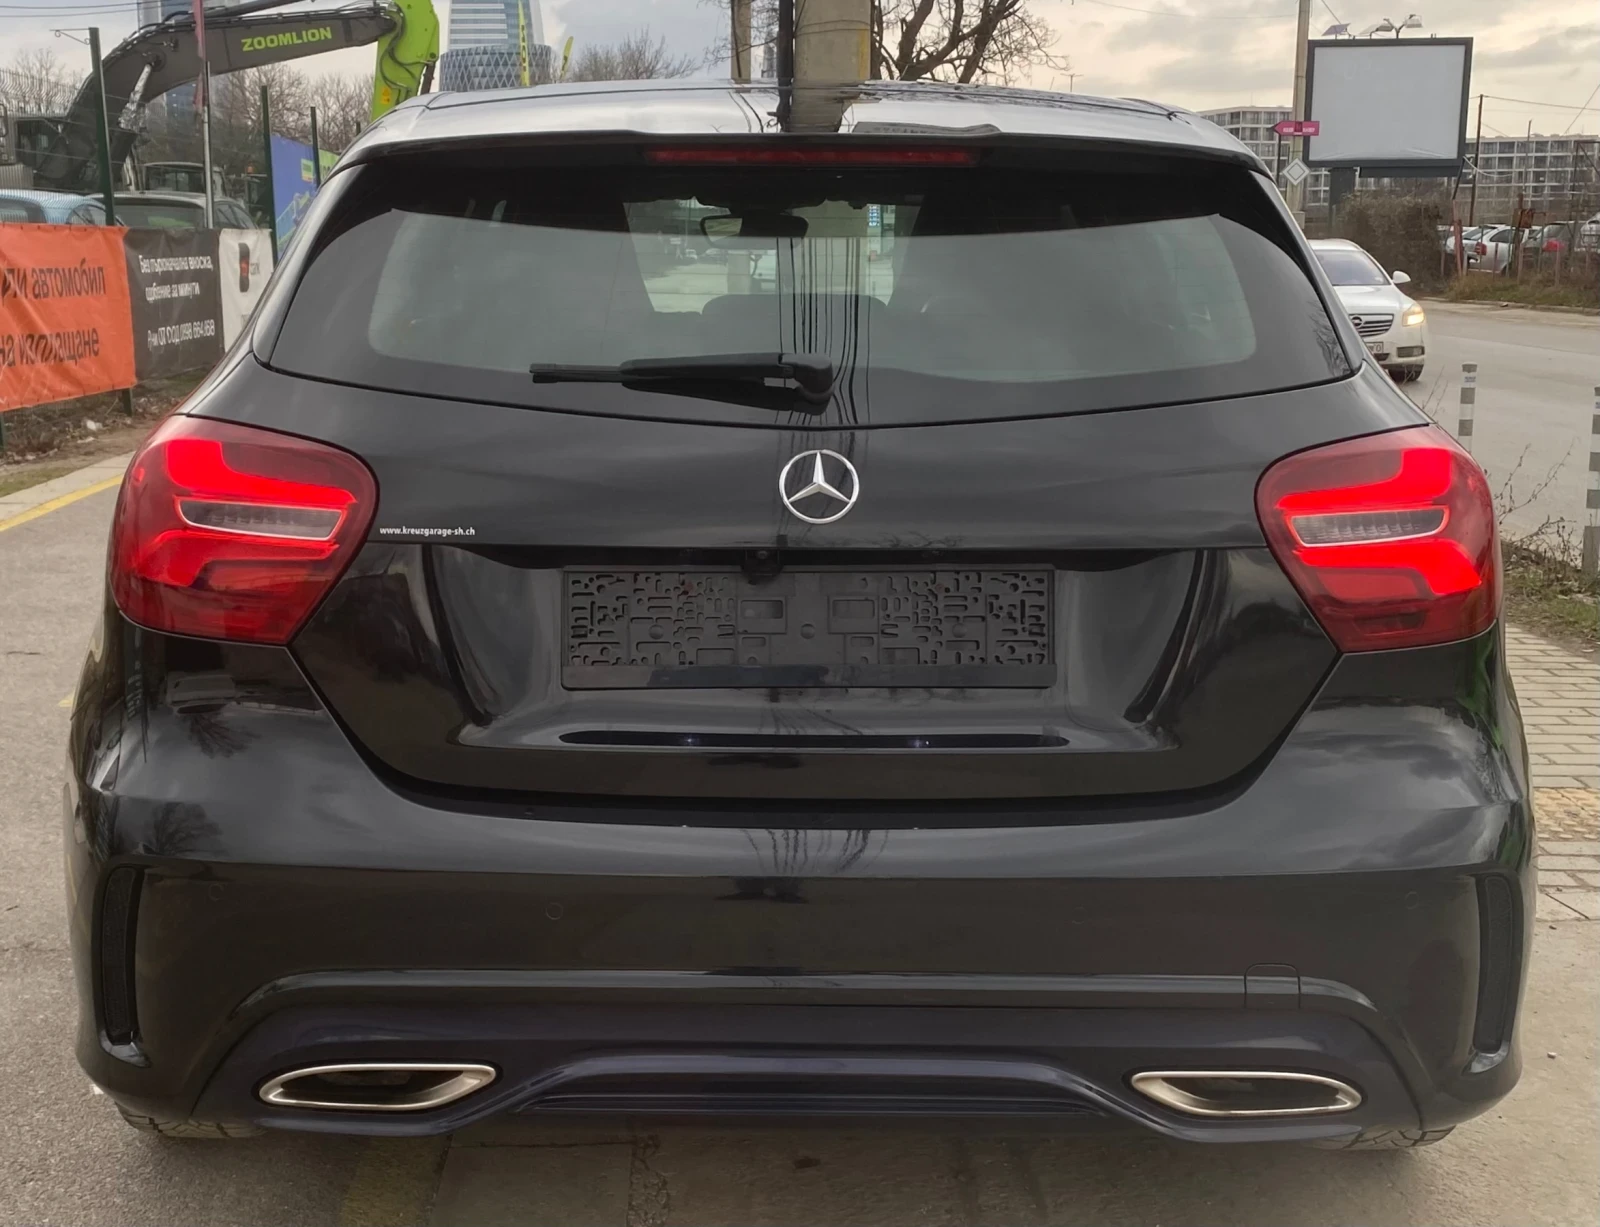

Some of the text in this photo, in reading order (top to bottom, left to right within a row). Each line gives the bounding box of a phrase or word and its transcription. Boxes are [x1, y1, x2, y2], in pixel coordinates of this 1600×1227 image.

[241, 27, 332, 51] ZOOMLION
[31, 257, 106, 299] автомобил
[379, 525, 476, 538] www.kreuzgarage-sh.ch
